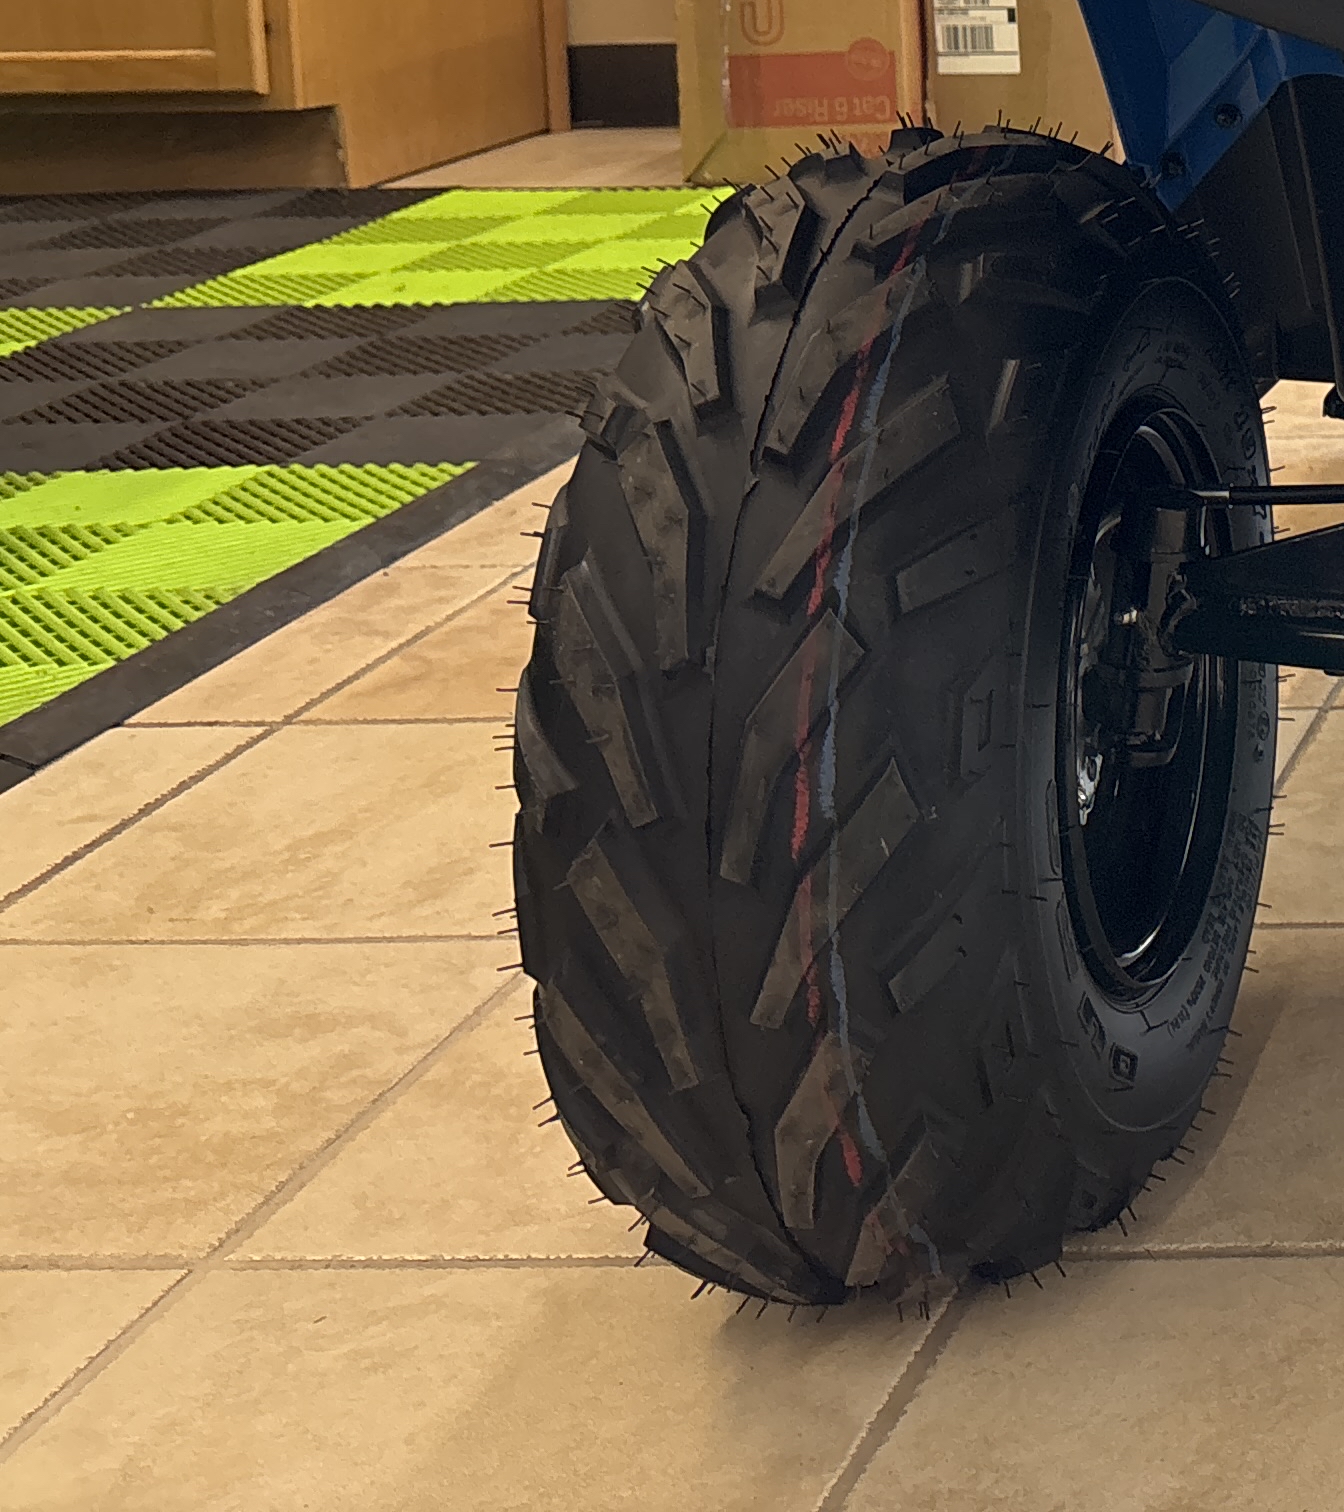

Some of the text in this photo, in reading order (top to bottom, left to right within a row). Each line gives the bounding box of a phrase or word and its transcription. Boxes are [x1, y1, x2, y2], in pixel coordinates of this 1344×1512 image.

[773, 95, 891, 122] Cat 6 Riser
